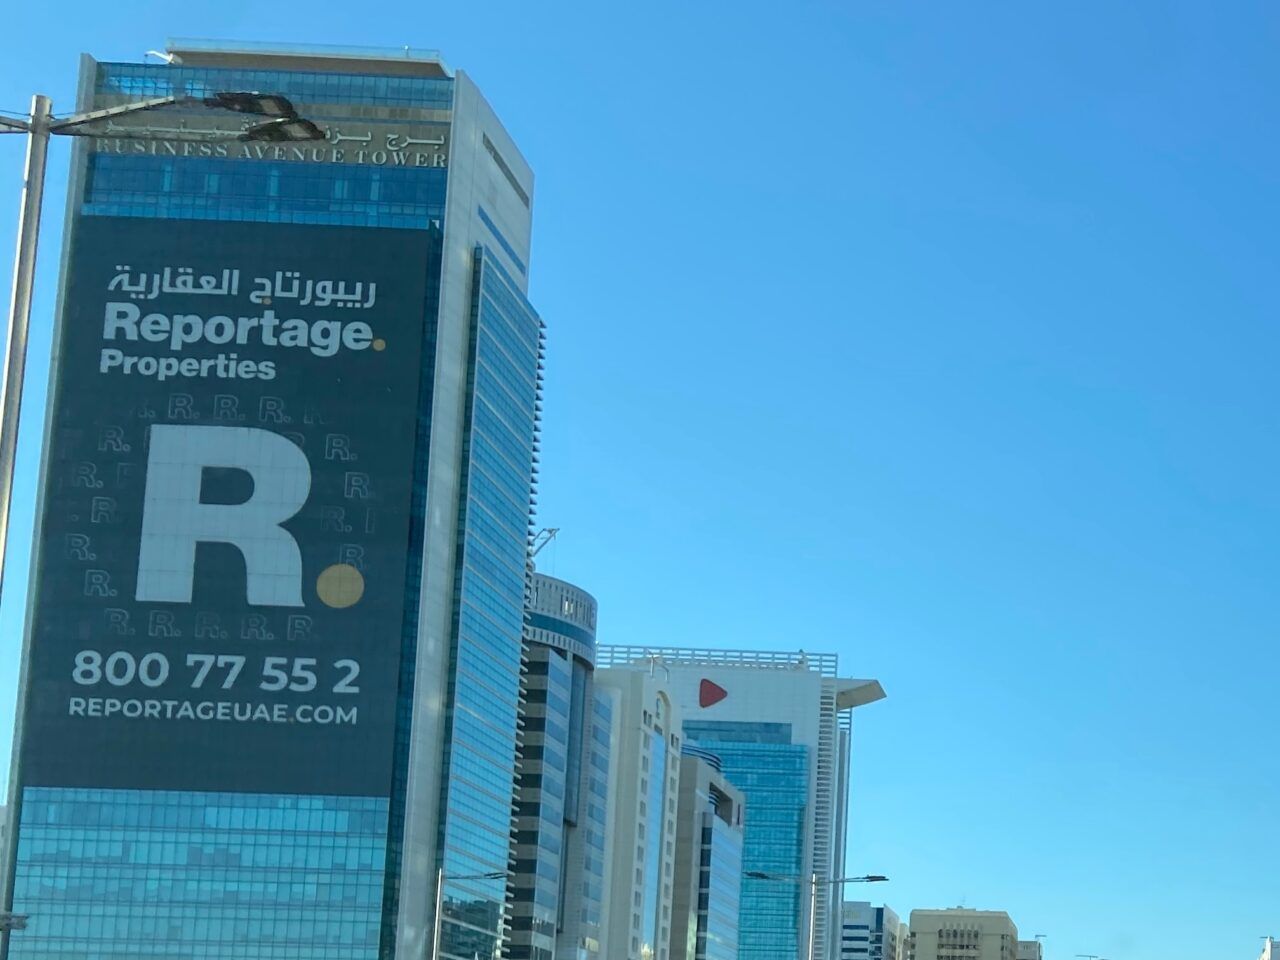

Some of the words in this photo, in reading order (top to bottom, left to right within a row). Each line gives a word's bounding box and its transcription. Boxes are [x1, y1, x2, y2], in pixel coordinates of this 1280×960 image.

[95, 136, 228, 158] BUSINESS
[238, 142, 346, 163] AVENUE
[352, 149, 448, 168] TOWER
[107, 264, 241, 300] العقارية
[249, 270, 378, 309] ريبورتاج
[99, 348, 277, 382] Properties
[71, 649, 171, 688] 800
[185, 653, 247, 690] 77
[259, 656, 318, 693] 55
[332, 658, 361, 694] 2
[67, 696, 359, 726] REPORTAGEUAE.COM
